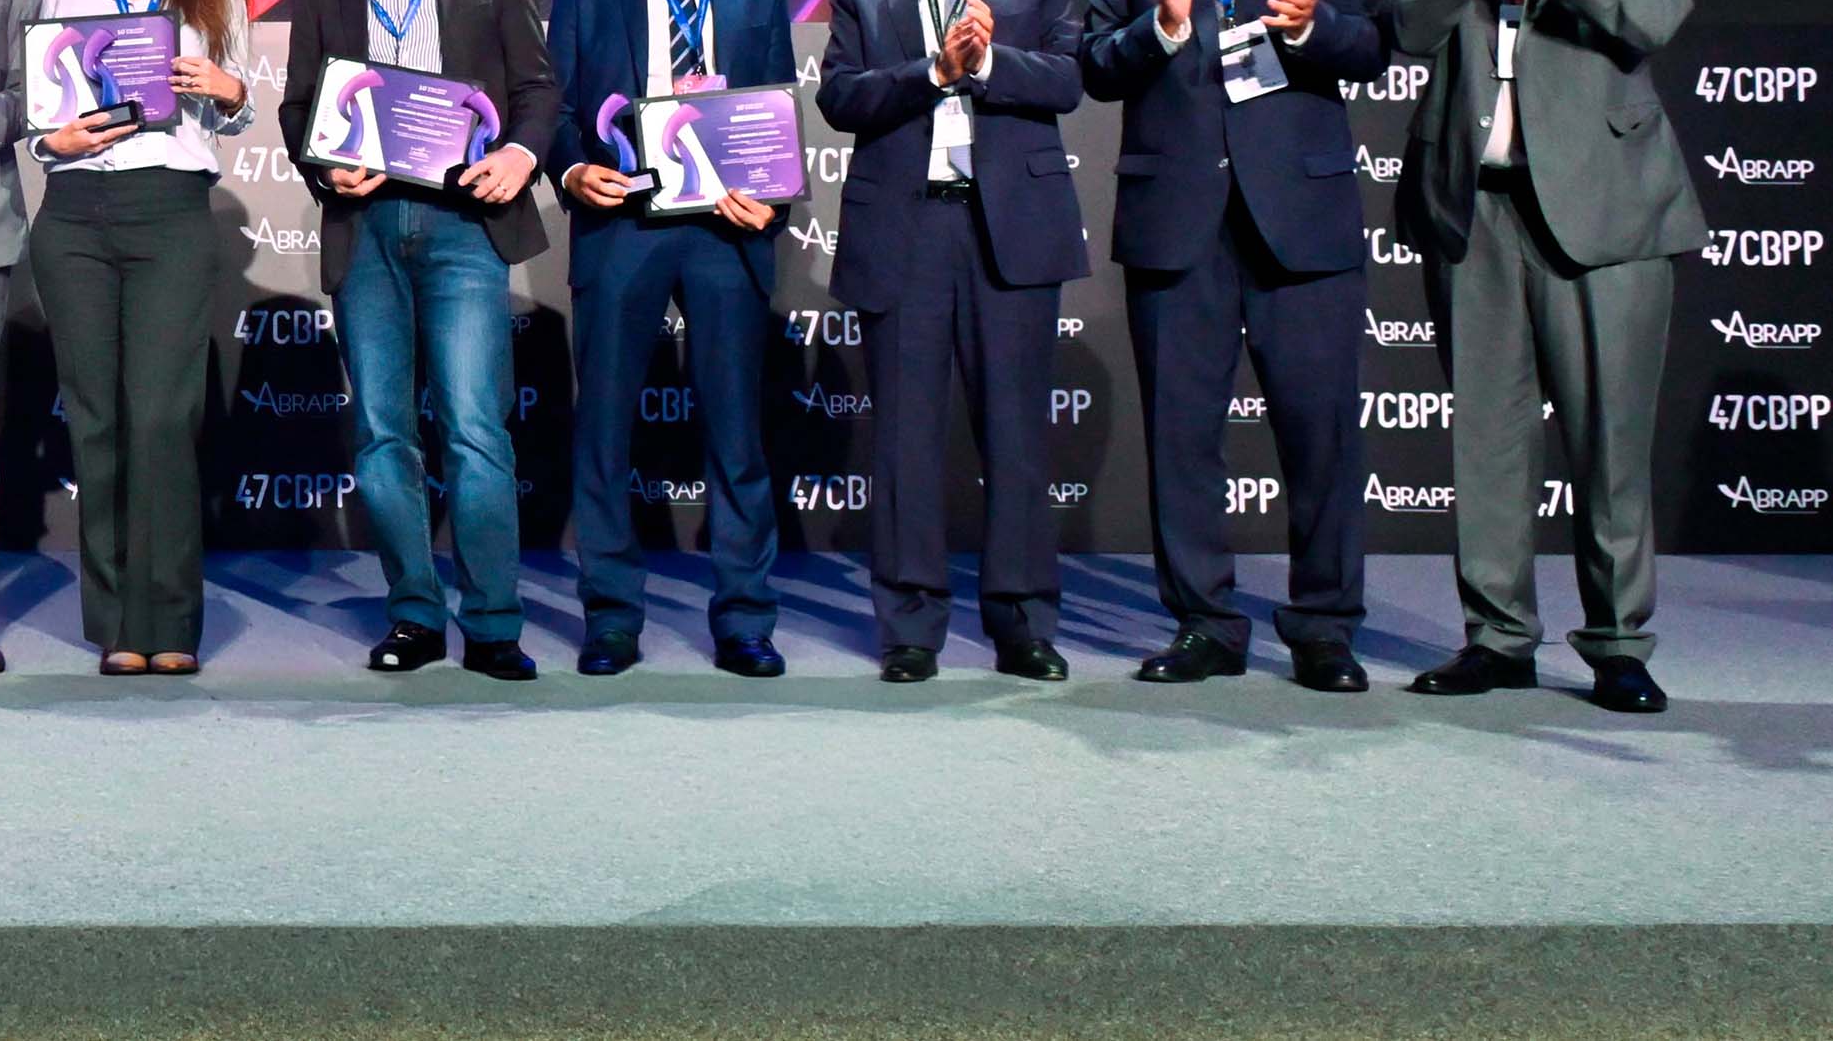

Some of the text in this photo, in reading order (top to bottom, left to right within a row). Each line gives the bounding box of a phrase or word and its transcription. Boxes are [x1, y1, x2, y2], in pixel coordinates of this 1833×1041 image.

[1695, 66, 1818, 102] 47CBPP
[1704, 146, 1815, 185] ABRAPP
[240, 217, 321, 254] ABRA
[1702, 229, 1824, 266] 47CBPP
[234, 310, 339, 345] 47CBP
[784, 310, 862, 346] 47CB
[1711, 310, 1822, 349] ABRAPP
[792, 382, 873, 418] ABRA
[1708, 394, 1831, 430] 47CBPP
[235, 473, 357, 509] 47CBPP
[789, 475, 872, 510] 47CB
[1718, 476, 1829, 515] ABRAPP
